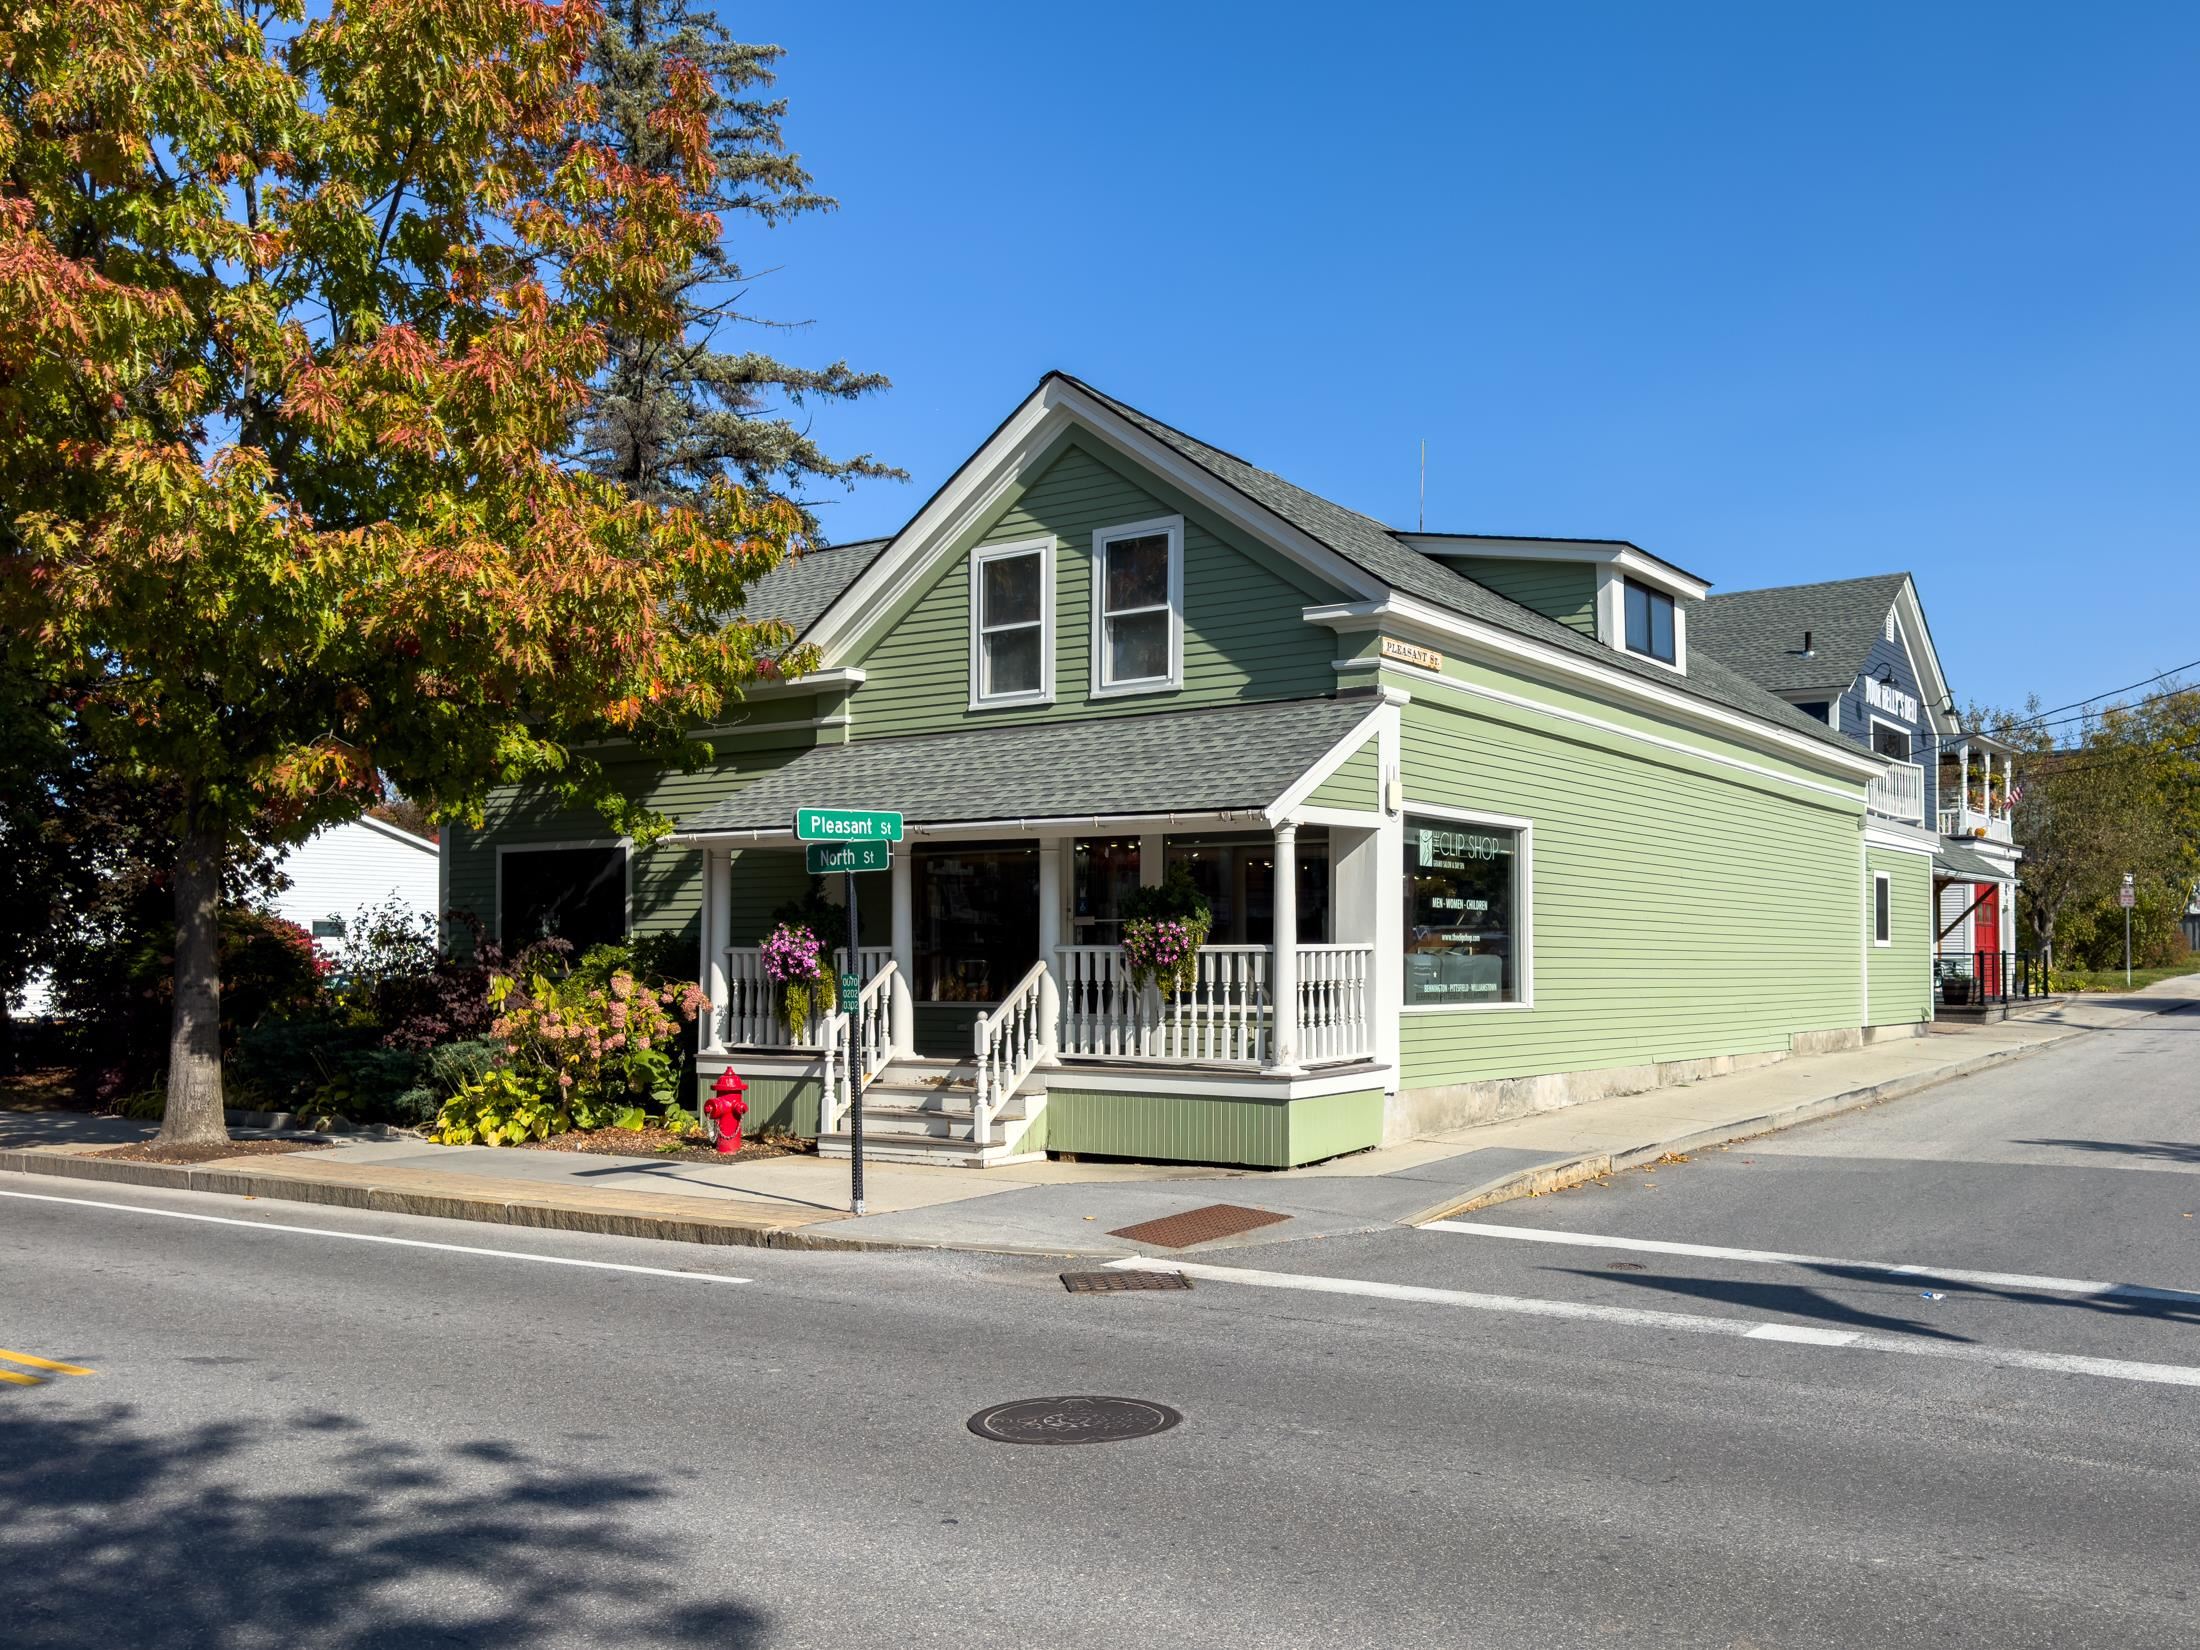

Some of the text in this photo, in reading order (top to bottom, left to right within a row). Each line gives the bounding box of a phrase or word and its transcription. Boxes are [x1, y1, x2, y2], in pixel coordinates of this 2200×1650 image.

[1387, 642, 1427, 662] PLEASANT
[811, 815, 892, 835] Pleasant St
[1440, 832, 1499, 860] CLIP SHOP
[821, 849, 874, 866] North St
[1432, 897, 1443, 908] MEN
[1446, 898, 1463, 909] WOMEN
[1466, 899, 1488, 911] CHILDREN
[842, 989, 857, 998] 0202
